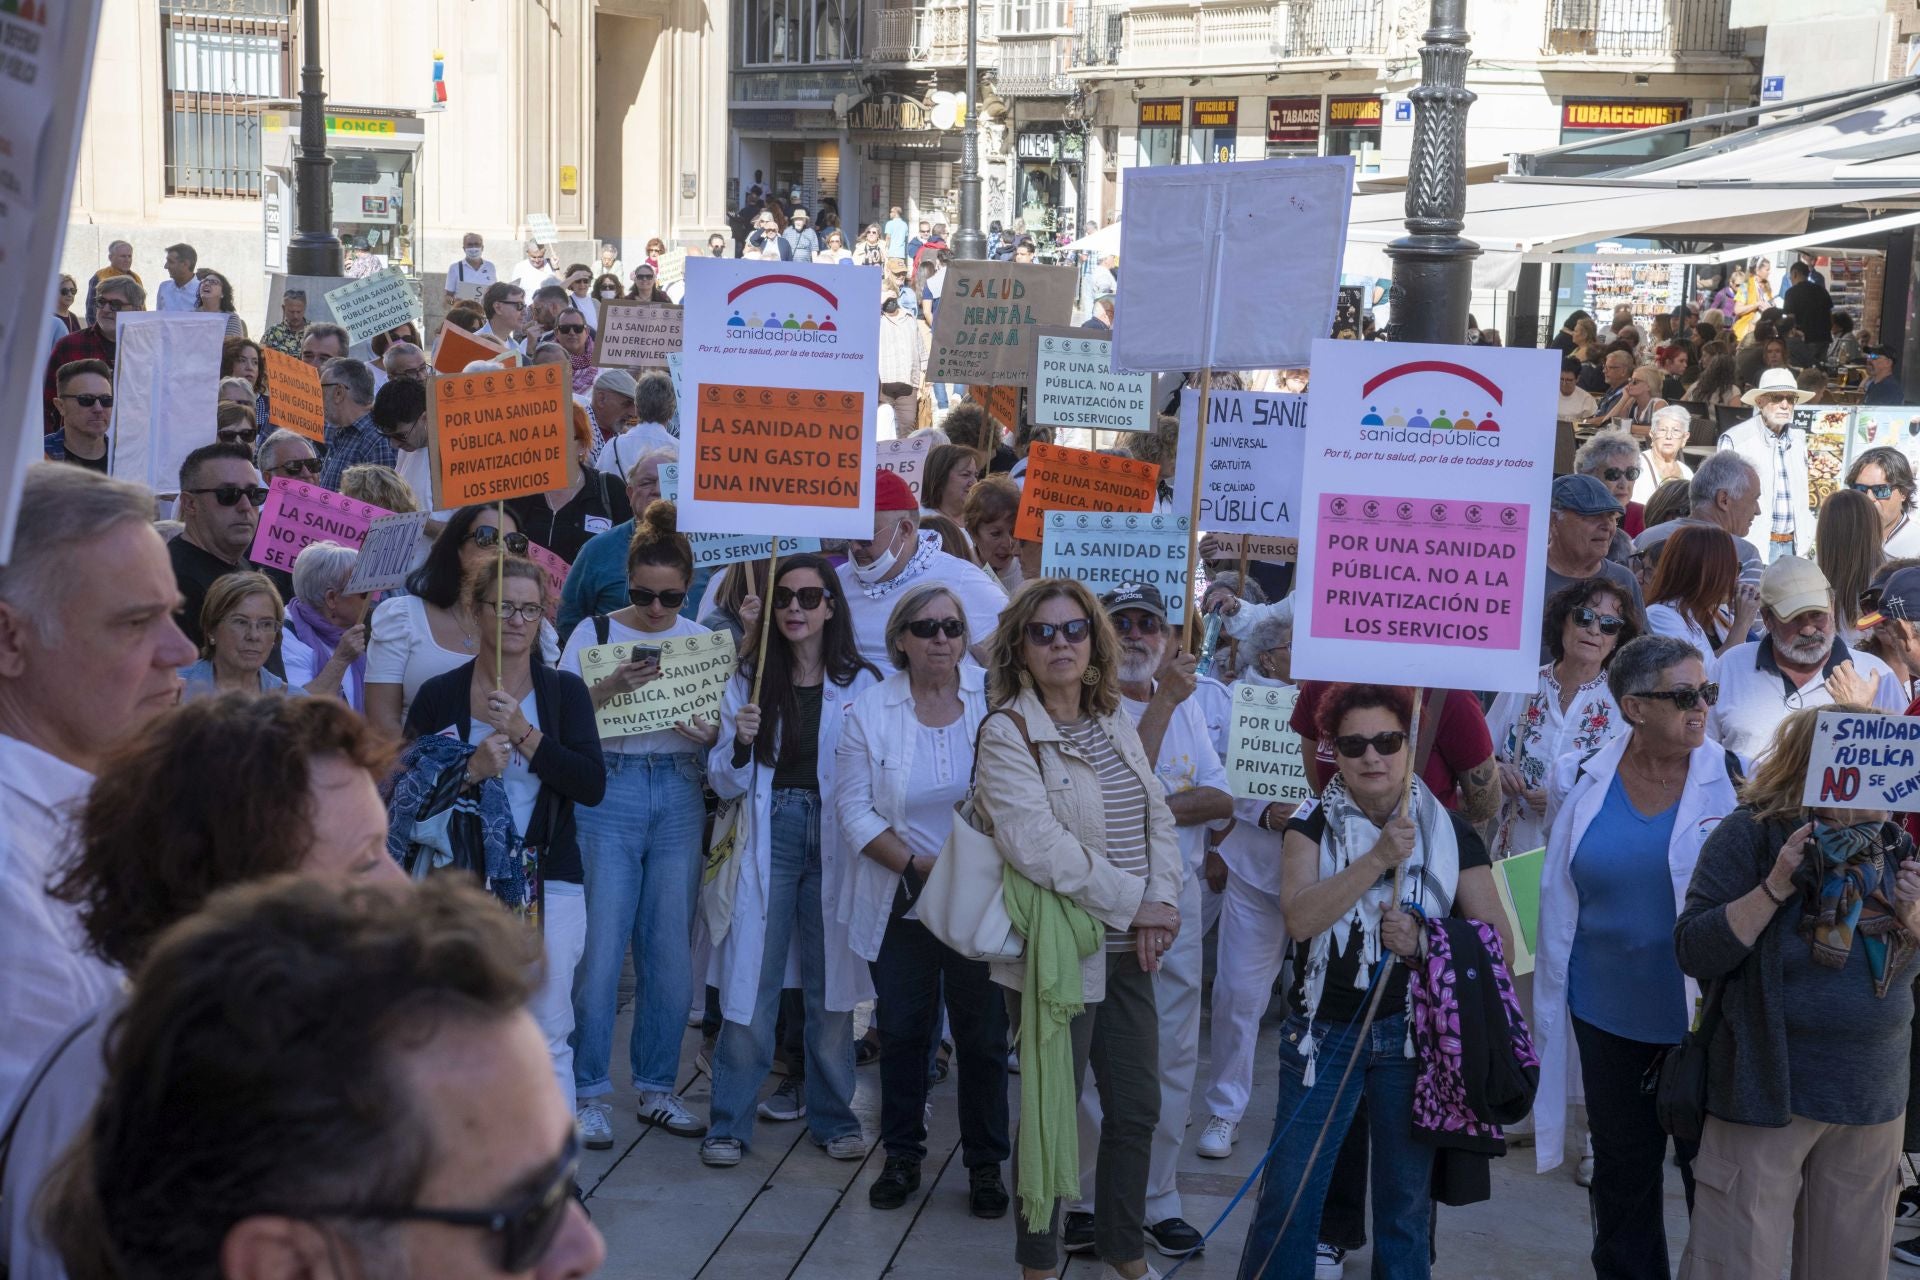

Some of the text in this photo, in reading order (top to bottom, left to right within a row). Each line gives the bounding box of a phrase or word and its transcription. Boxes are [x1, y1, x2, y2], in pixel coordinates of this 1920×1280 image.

[1282, 109, 1320, 123] TABACOS
[1331, 102, 1381, 119] SOUVENIRS
[1568, 105, 1683, 124] TOBACCONIST
[342, 120, 388, 133] ONCE
[1019, 134, 1049, 156] OLEA
[335, 280, 404, 313] POR UNA SANIDAD
[377, 298, 390, 307] NO
[397, 290, 408, 299] LA
[955, 278, 1025, 300] SALUD
[403, 298, 414, 308] DE
[963, 304, 1037, 325] MENTAL
[358, 312, 411, 339] LOS SERVICIOS
[611, 322, 680, 334] LA SANIDAD ES
[726, 327, 837, 343] sanidadpública
[604, 335, 683, 347] UN DERECHO NO
[607, 348, 672, 360] UN PRIVILEG
[698, 344, 713, 352] Por
[774, 350, 789, 358] por
[799, 349, 810, 357] de
[810, 350, 833, 359] todas
[841, 352, 864, 360] todos
[1043, 361, 1095, 373] POR UNA
[269, 368, 322, 398] LA SANIDAD NO
[1045, 376, 1142, 393] PÚBLICA. NO A LA
[270, 387, 279, 399] ES
[279, 392, 291, 405] UN
[292, 396, 314, 413] GASTO
[1043, 394, 1144, 410] PRIVATIZACIÓN DE
[445, 399, 558, 428] POR UNA SANIDAD
[1053, 411, 1133, 426] LOS SERVICIOS
[450, 423, 558, 452] PÚBLICA. NO A LA
[701, 417, 860, 441] LA SANIDAD NO
[1359, 427, 1500, 448] sanidadpública
[1213, 433, 1267, 449] UNIVERSAL
[450, 446, 560, 477] PRIVATIZACIÓN DE
[700, 445, 721, 462] ES
[728, 447, 758, 464] UN
[765, 449, 831, 468] GASTO
[837, 452, 859, 469] ES
[1211, 457, 1251, 470] GRATUITA
[1323, 448, 1342, 458] Por
[1354, 452, 1373, 461] por
[1374, 451, 1385, 460] tu
[1386, 452, 1417, 464] salud,
[1418, 455, 1438, 465] por
[1439, 455, 1449, 464] la
[1450, 455, 1464, 465] de
[1465, 456, 1494, 467] todas
[1494, 458, 1503, 468] y
[1504, 457, 1534, 468] todos
[463, 471, 550, 499] LOS SERVICIOS
[698, 473, 858, 497] UNA INVERSIÓN
[1033, 469, 1150, 501] POR UNA SANIDAD
[1211, 481, 1256, 492] DE CALIDAD
[1032, 487, 1114, 513] PÚBLICA. NO
[1199, 495, 1290, 522] PÚBLICA
[279, 503, 300, 522] LA
[268, 525, 295, 544] NO
[264, 548, 284, 565] SE
[694, 538, 798, 563] LOS SERVICOS
[1054, 542, 1186, 559] LA SANIDAD ES
[1328, 534, 1516, 559] POR UNA SANIDAD
[1077, 567, 1159, 584] DERECHO
[1331, 559, 1509, 587] PÚBLICA. NO A LA
[1115, 592, 1143, 603] adidas
[1326, 589, 1511, 615] PRIVATIZACIÓN DE
[1344, 617, 1489, 641] LOS SERVICIOS
[665, 654, 731, 679] SANIDAD
[673, 672, 731, 698] NO A LA
[603, 692, 717, 726] PRIVATIZACIÓN
[623, 724, 652, 734] LOS
[1240, 715, 1270, 731] POR
[1834, 743, 1914, 767] PÚBLICA
[1248, 781, 1278, 796] LOS
[1820, 766, 1886, 803] NO SE
